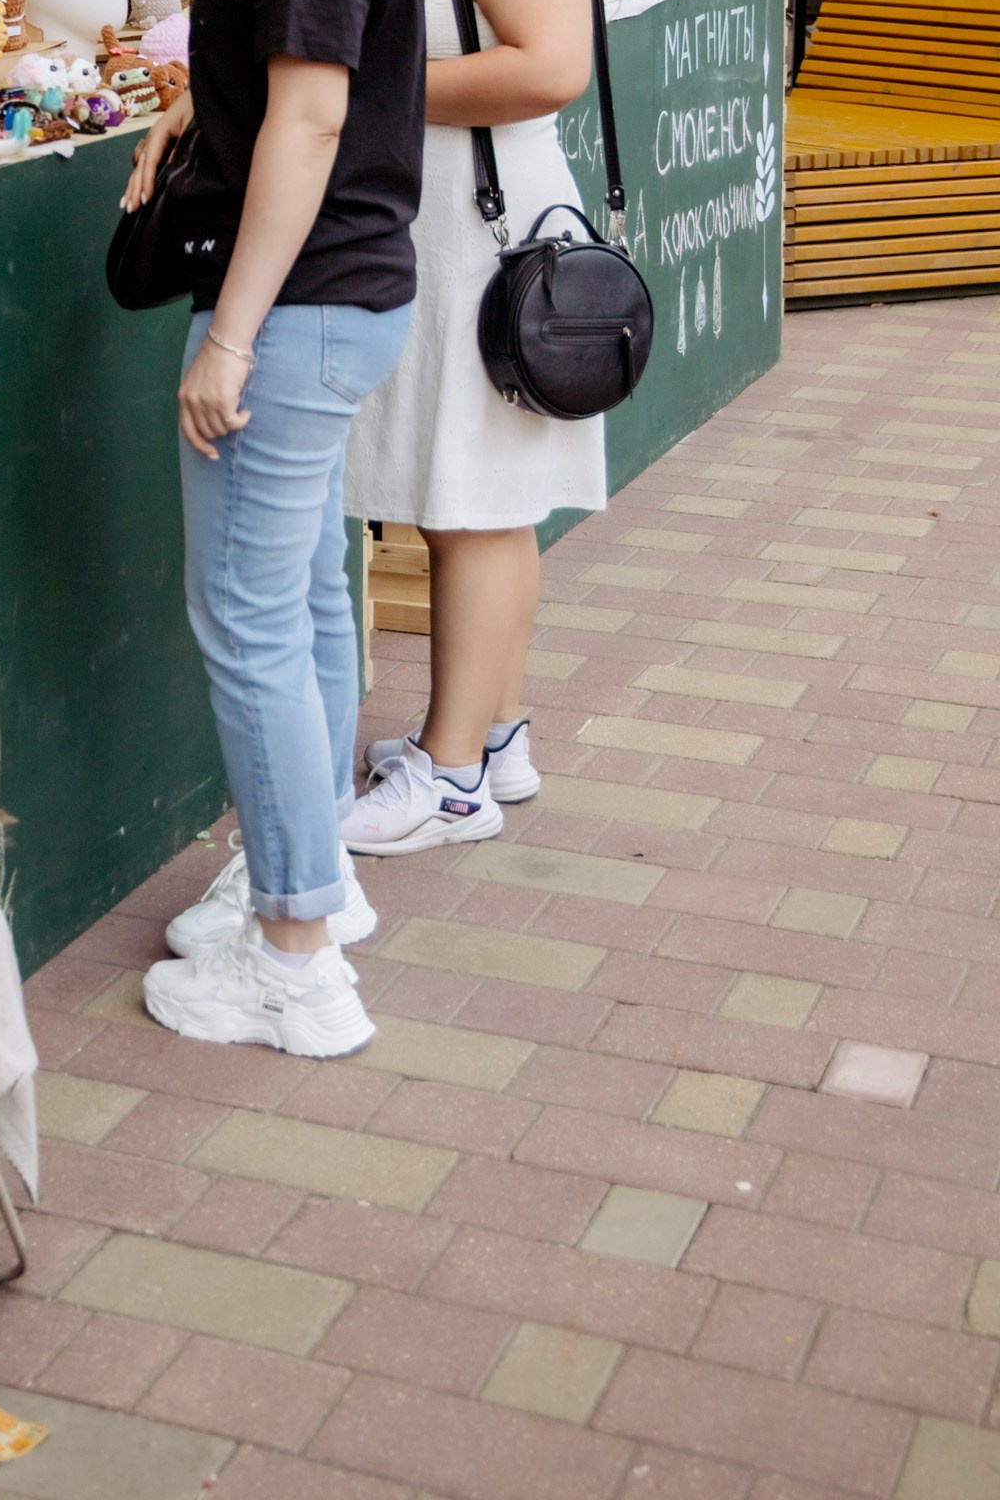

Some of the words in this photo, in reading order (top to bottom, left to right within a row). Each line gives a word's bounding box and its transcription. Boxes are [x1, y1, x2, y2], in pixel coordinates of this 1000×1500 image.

[663, 3, 756, 87] МАГНИТЫ
[655, 95, 752, 177] СМОЛЕНСК
[660, 183, 758, 266] КОЛОКОЛЬЧИКИ
